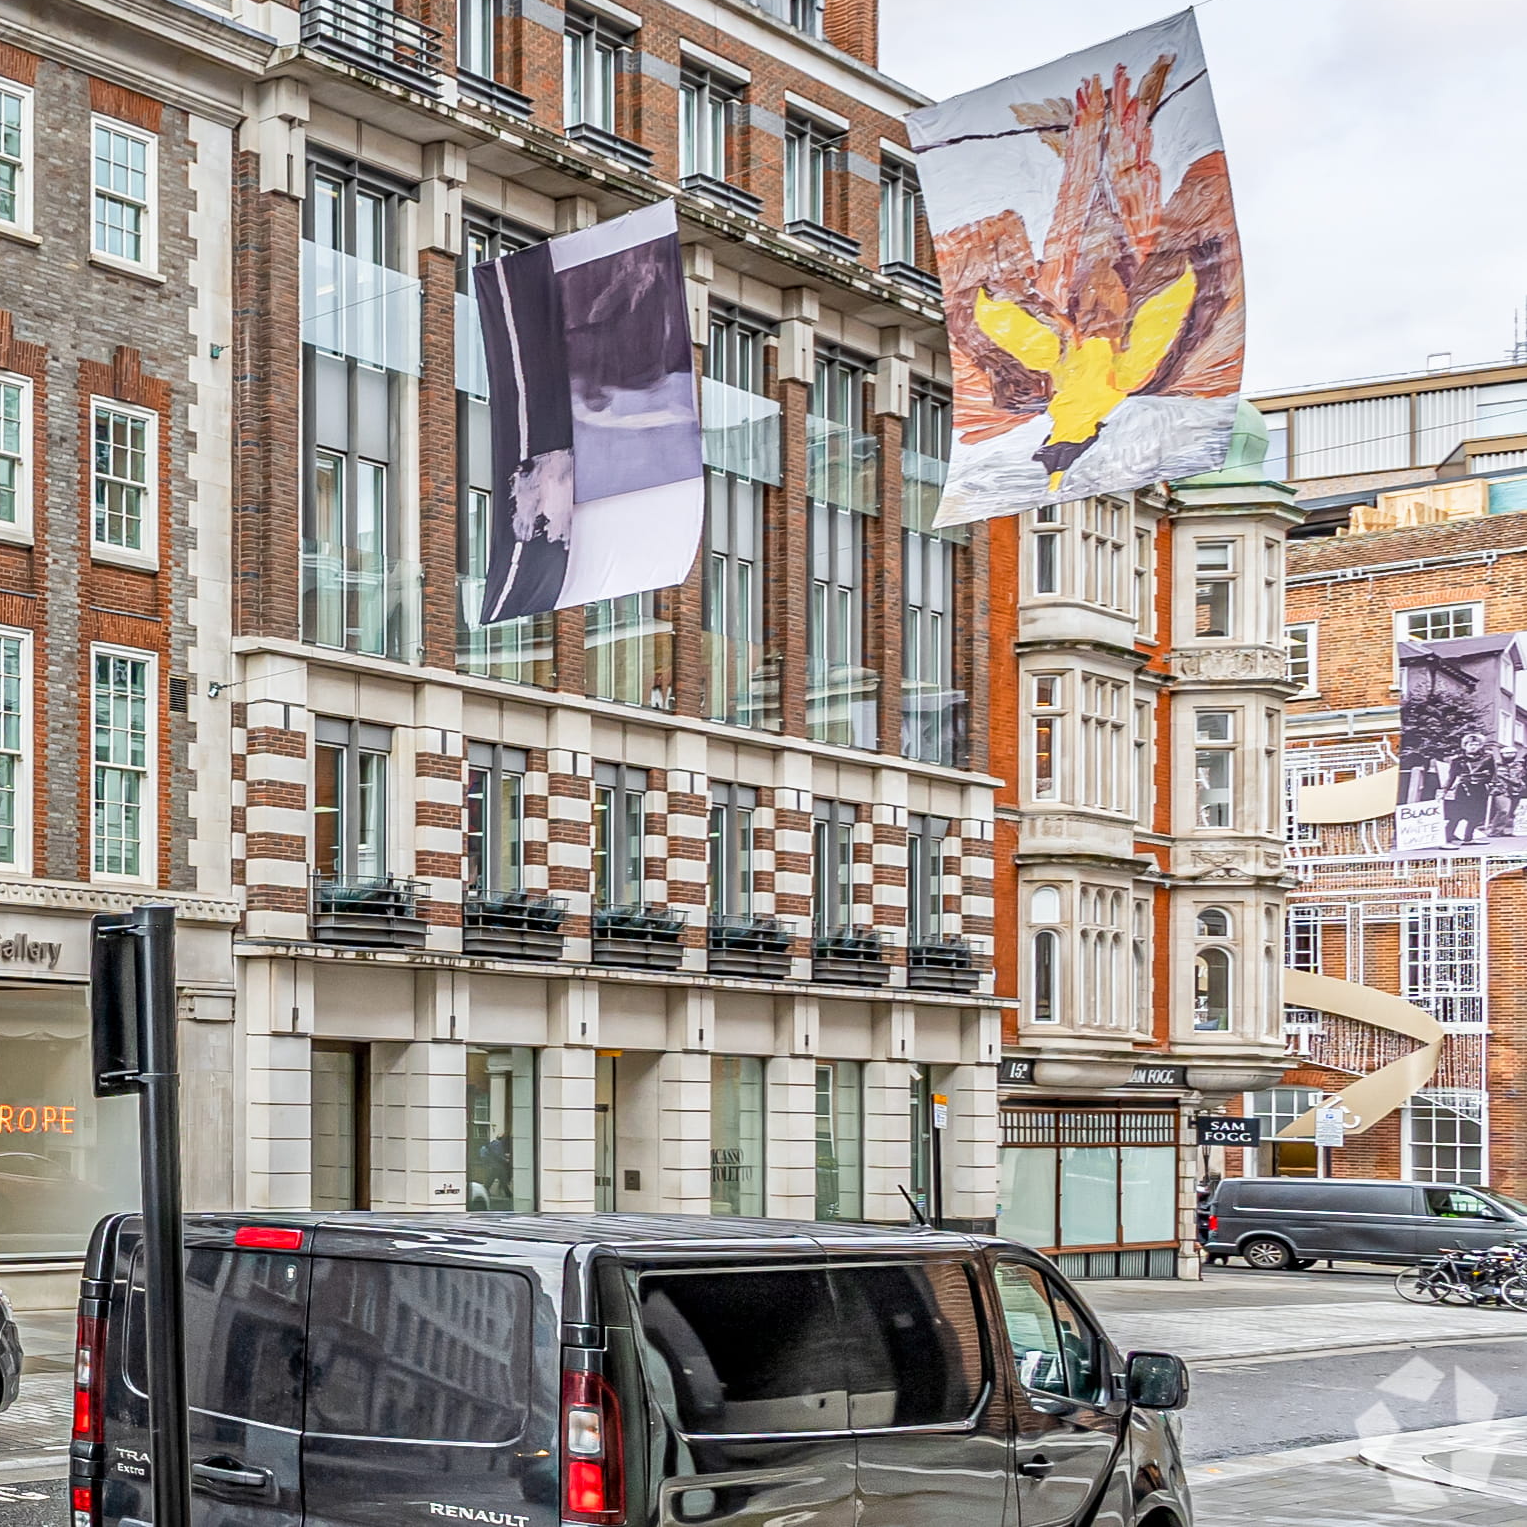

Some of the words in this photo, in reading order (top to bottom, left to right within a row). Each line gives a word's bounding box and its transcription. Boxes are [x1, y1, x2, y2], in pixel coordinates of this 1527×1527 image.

[1401, 806, 1441, 820] BLACK
[1147, 1069, 1175, 1084] FOGG
[1210, 1120, 1246, 1131] SAM
[1204, 1131, 1252, 1142] FOGG
[117, 1462, 145, 1476] Extra
[429, 1502, 530, 1527] RENAULT
